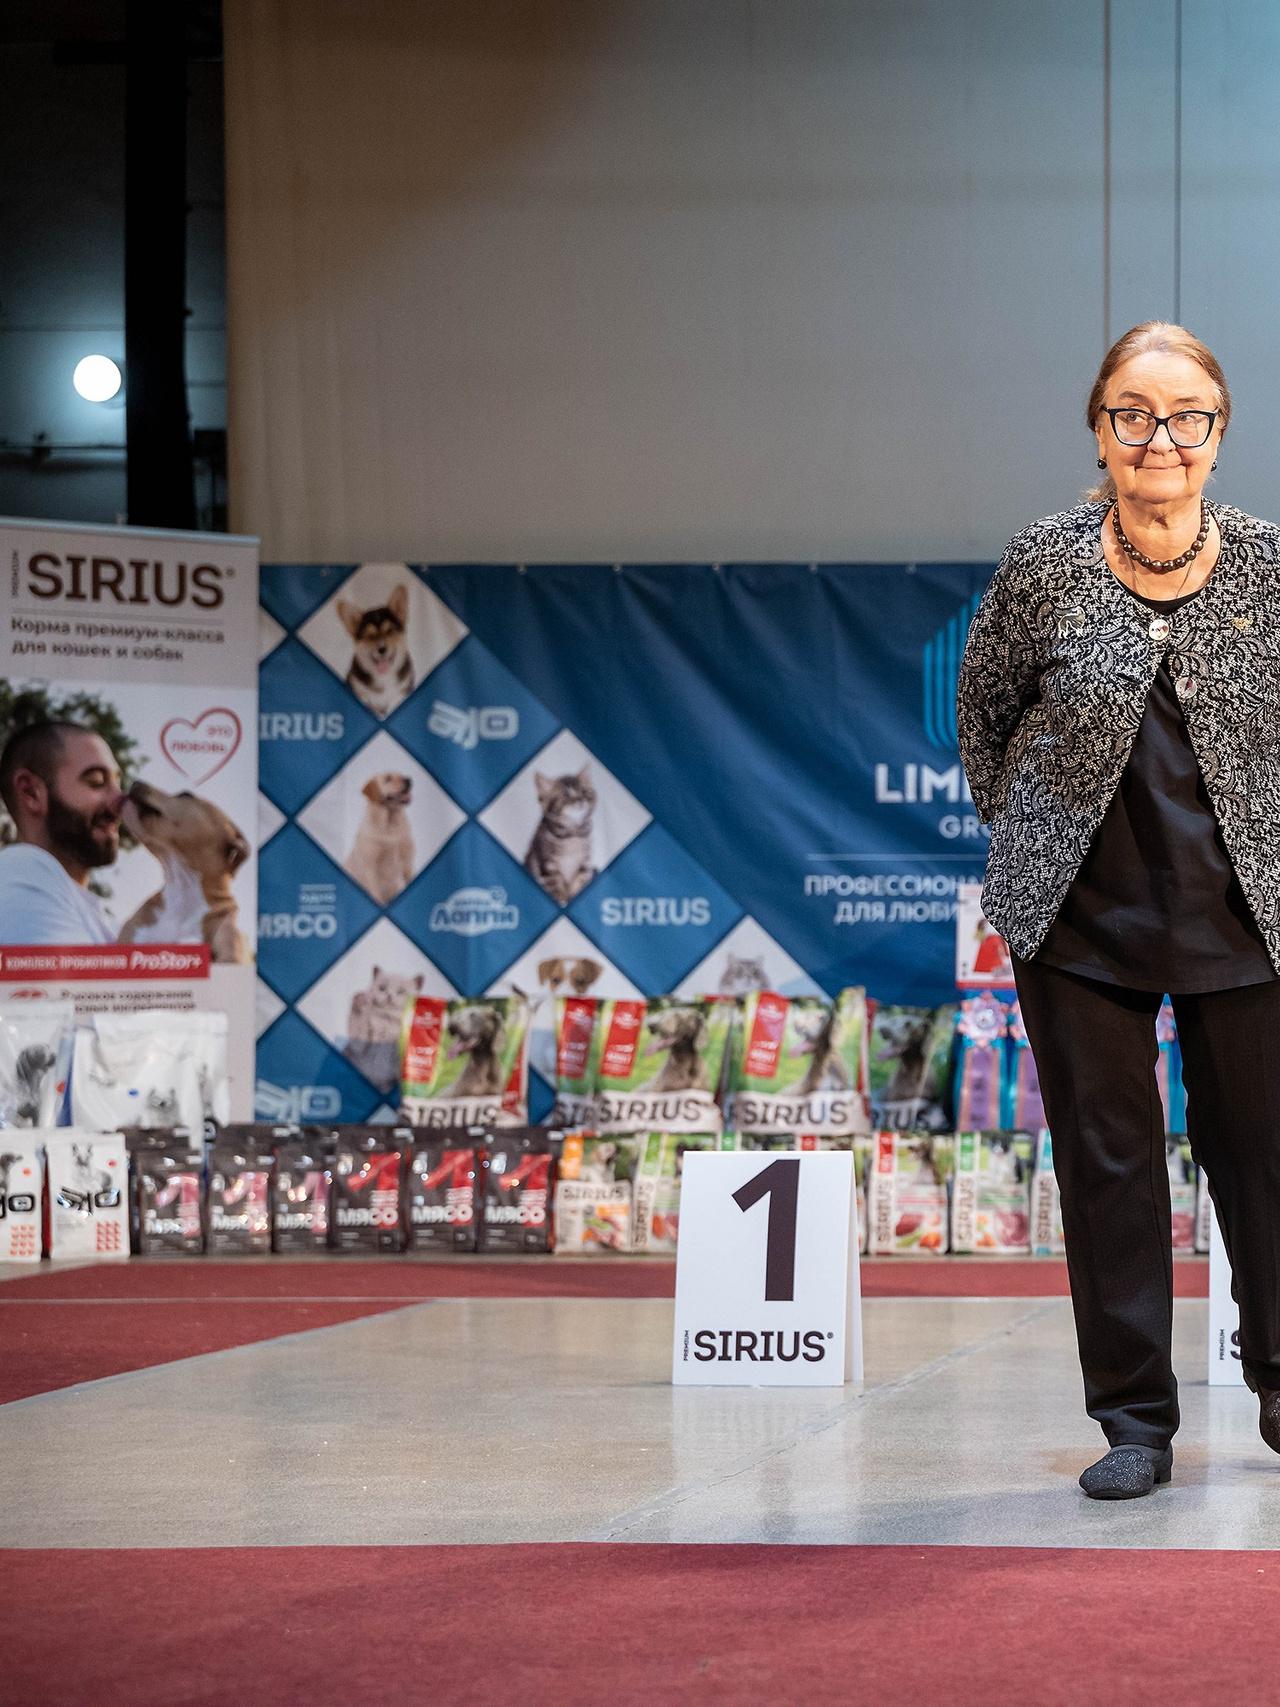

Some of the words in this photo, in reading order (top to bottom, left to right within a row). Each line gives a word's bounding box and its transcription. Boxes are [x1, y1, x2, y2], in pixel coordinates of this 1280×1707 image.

[11, 617, 70, 636] Корма
[12, 641, 46, 655] для
[53, 643, 110, 657] кошек
[116, 645, 128, 658] и
[133, 644, 183, 661] собак
[259, 712, 344, 740] IRIUS
[835, 901, 886, 925] ДЛЯ
[599, 1098, 702, 1124] SIRIUS
[743, 1099, 849, 1126] SIRIUS
[731, 1159, 800, 1301] 1
